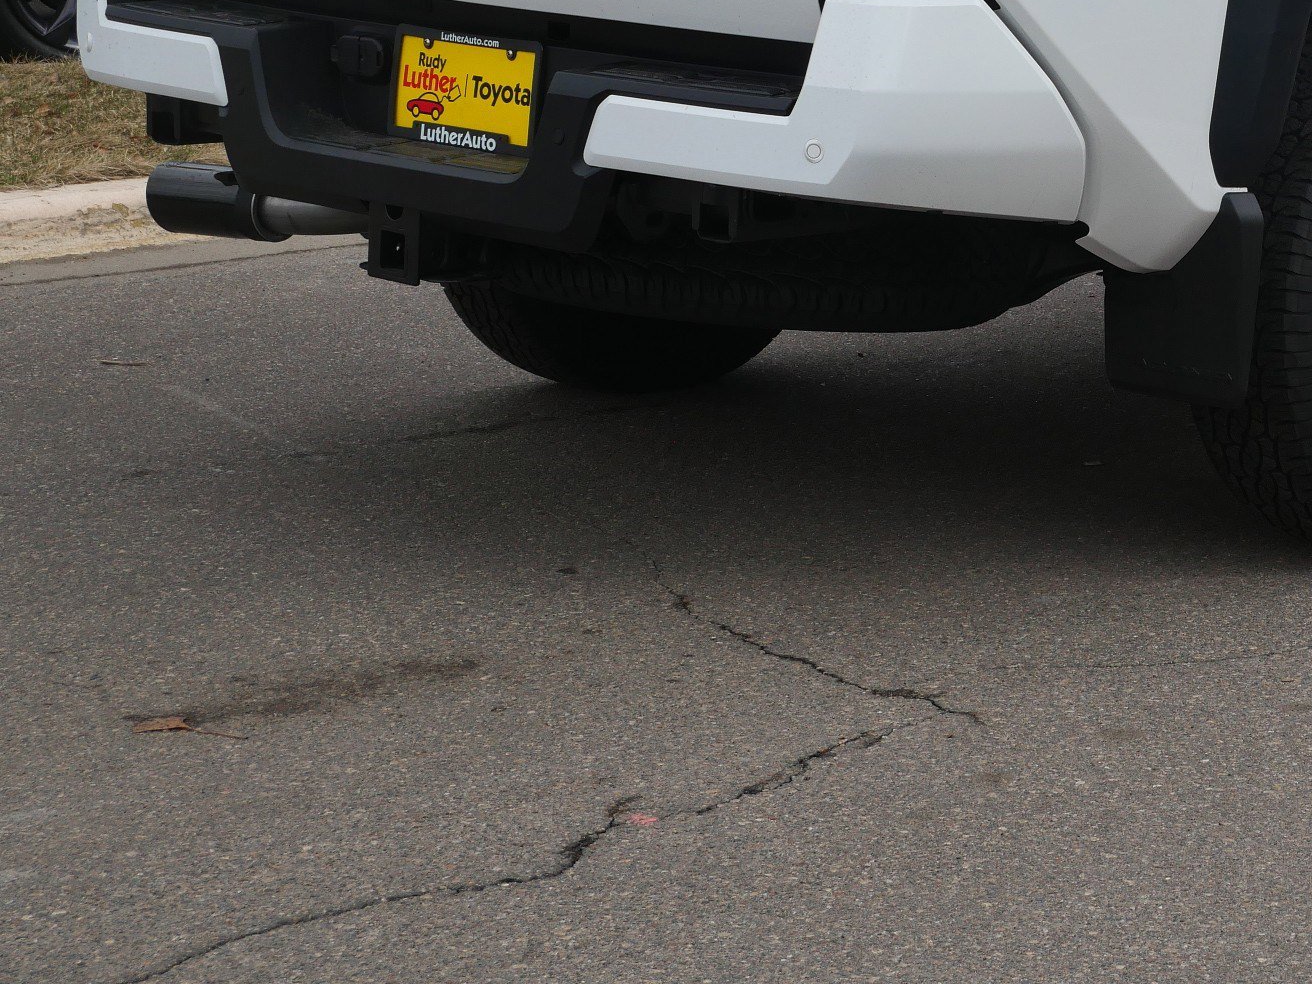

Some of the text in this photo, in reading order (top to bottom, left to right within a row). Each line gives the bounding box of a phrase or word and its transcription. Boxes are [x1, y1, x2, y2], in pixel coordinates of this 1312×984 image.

[440, 31, 500, 48] LutherAuto.com
[418, 51, 447, 73] Rudy
[402, 64, 532, 107] Luther Toyota
[420, 123, 497, 152] LutherAuto
